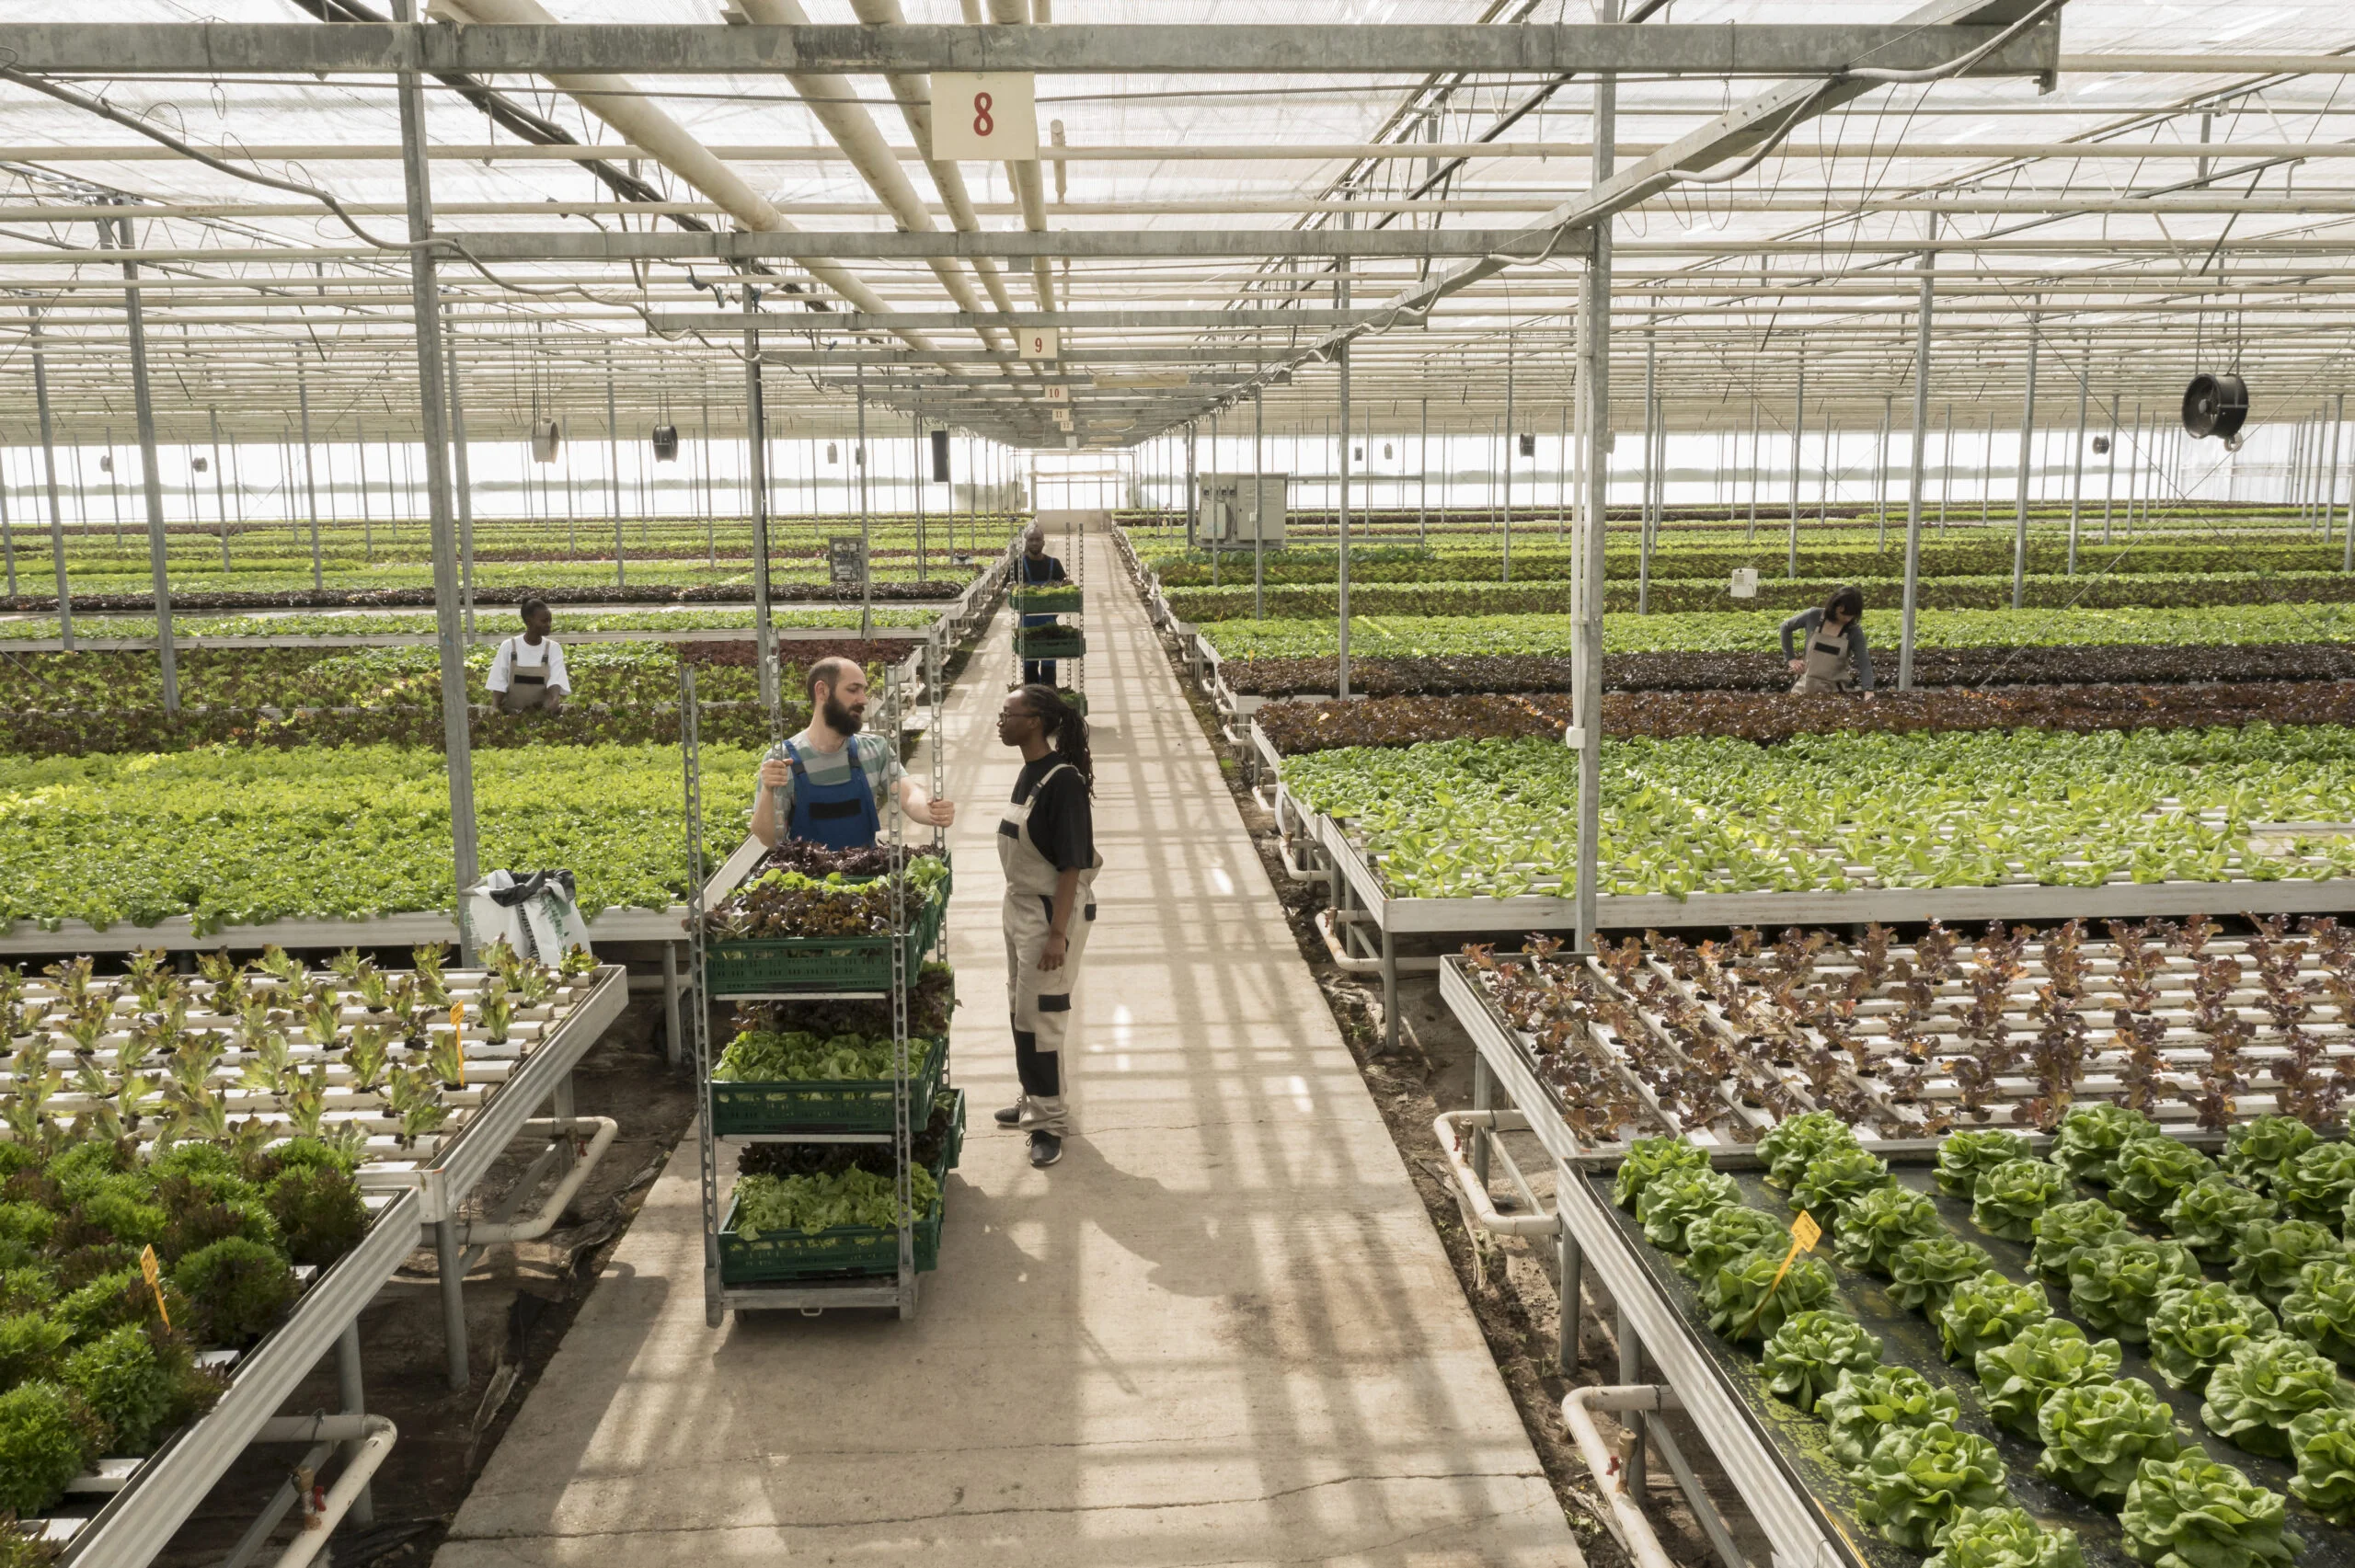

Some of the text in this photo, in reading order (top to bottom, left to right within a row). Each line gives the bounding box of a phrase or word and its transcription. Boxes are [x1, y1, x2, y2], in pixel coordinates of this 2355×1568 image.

[973, 92, 994, 136] 8
[1035, 338, 1042, 353] 9
[1049, 388, 1060, 398] 10
